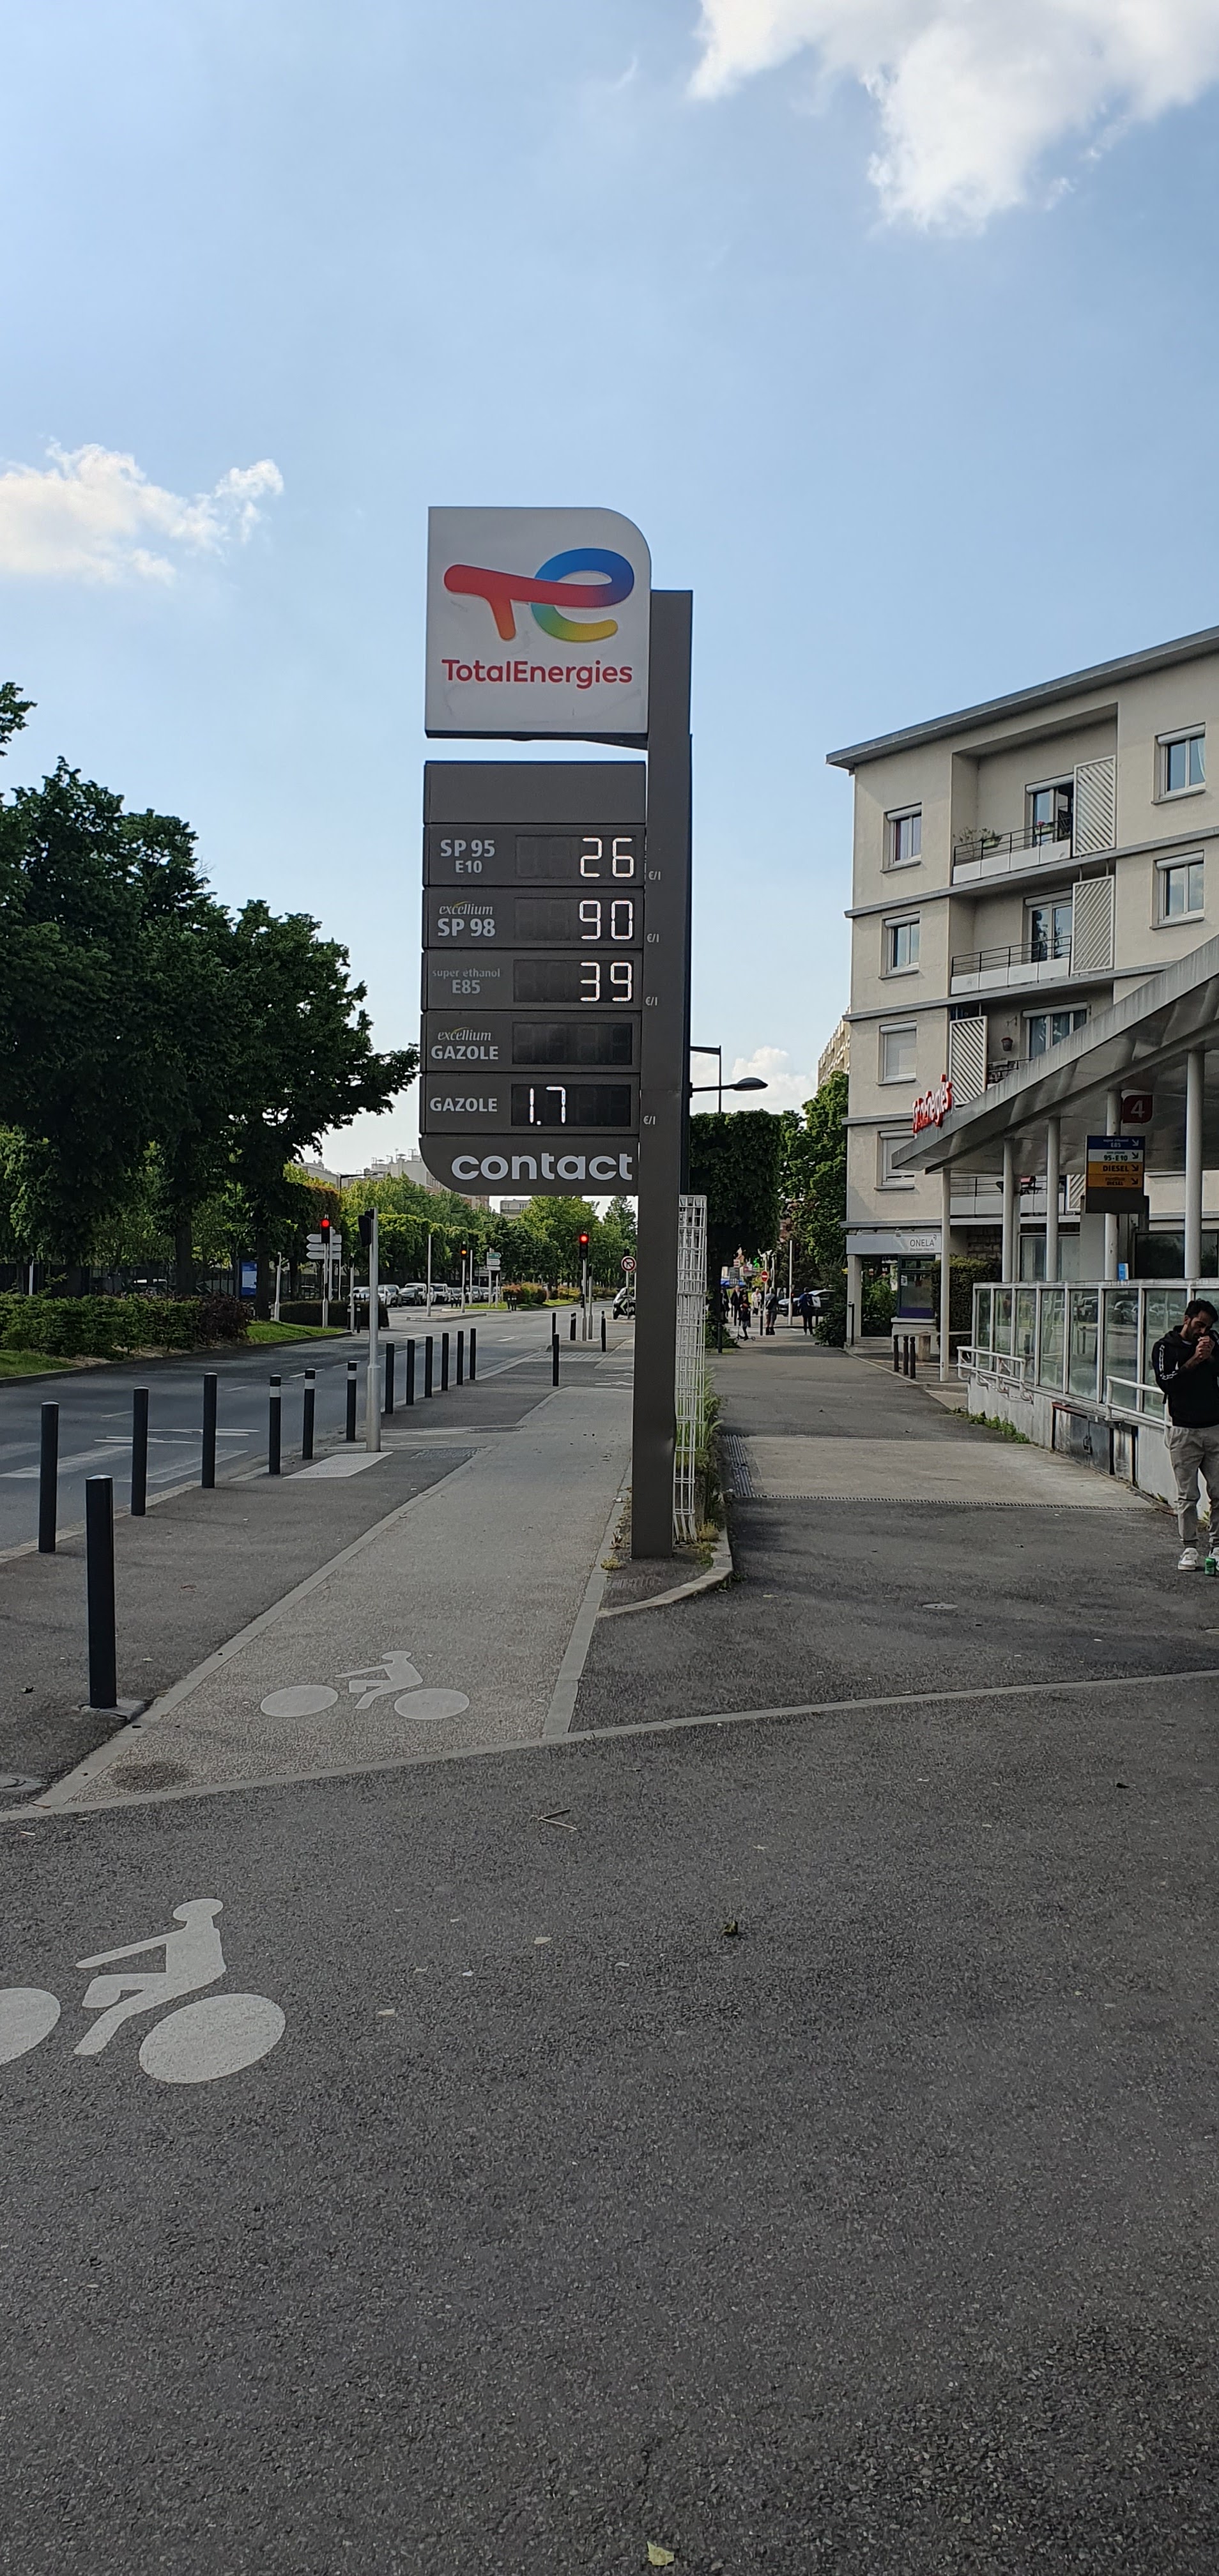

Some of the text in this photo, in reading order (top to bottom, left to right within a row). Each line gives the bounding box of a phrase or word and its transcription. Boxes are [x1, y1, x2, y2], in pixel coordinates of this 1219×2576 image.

[441, 659, 632, 689] TotalEnergies
[440, 839, 495, 857] SP 95
[455, 860, 482, 873] E10
[580, 838, 634, 878] 26
[439, 901, 493, 916] excellium
[438, 918, 496, 937] SP 98
[579, 900, 633, 940] 90
[433, 970, 459, 979] super
[580, 962, 632, 1002] 39
[452, 979, 480, 994] E85
[438, 1027, 491, 1041] excellium
[431, 1045, 498, 1060] GAZOLE
[430, 1097, 498, 1112] GAZOLE
[529, 1086, 566, 1125] 1.7
[1130, 1100, 1146, 1118] 4
[451, 1153, 632, 1181] contact
